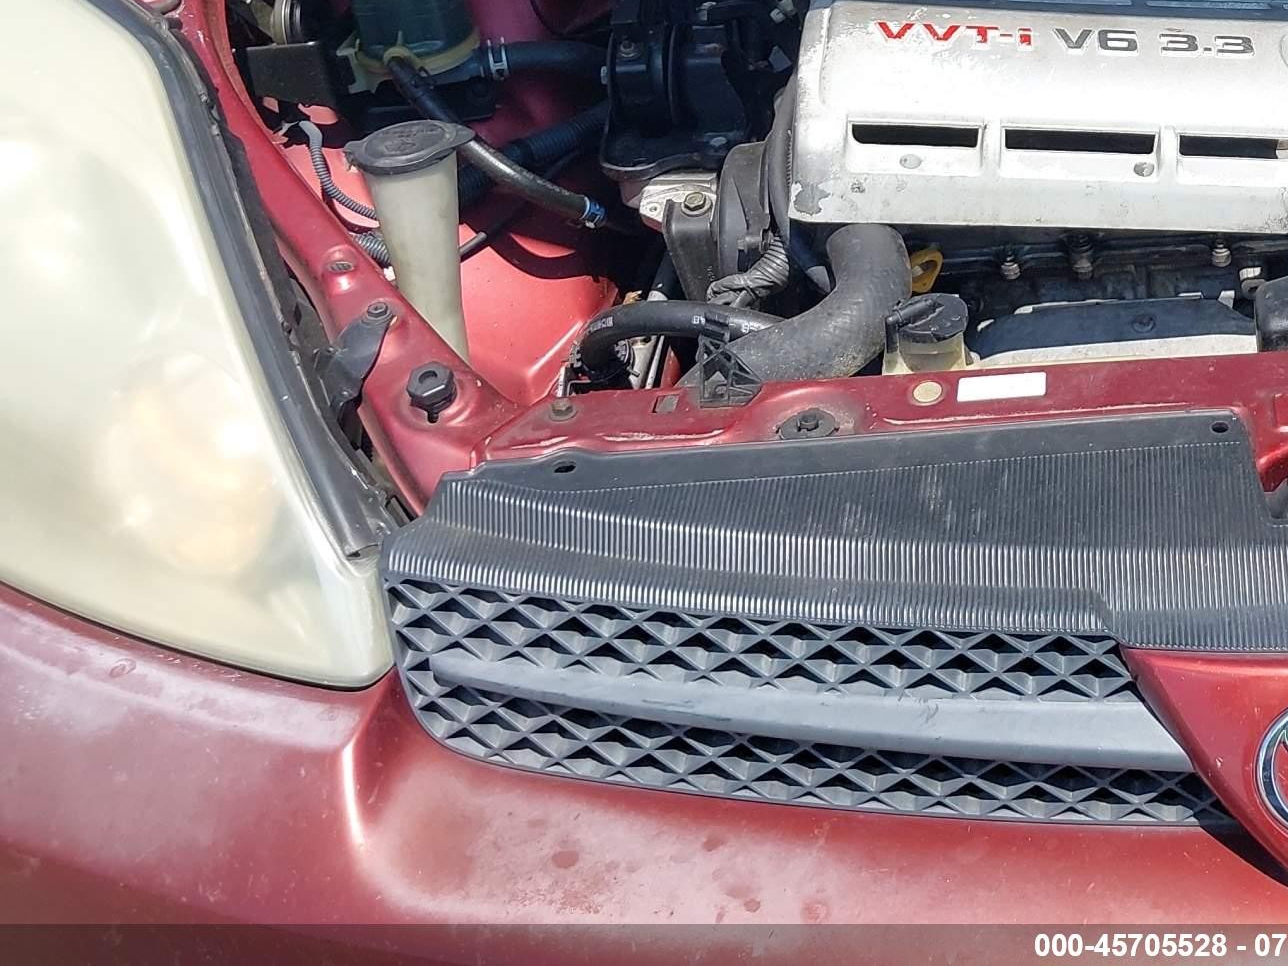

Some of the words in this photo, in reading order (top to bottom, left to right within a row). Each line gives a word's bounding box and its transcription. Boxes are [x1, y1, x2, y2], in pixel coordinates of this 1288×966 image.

[874, 20, 1033, 46] VVT-i
[1055, 27, 1140, 52] V6
[1158, 32, 1256, 56] 3.3
